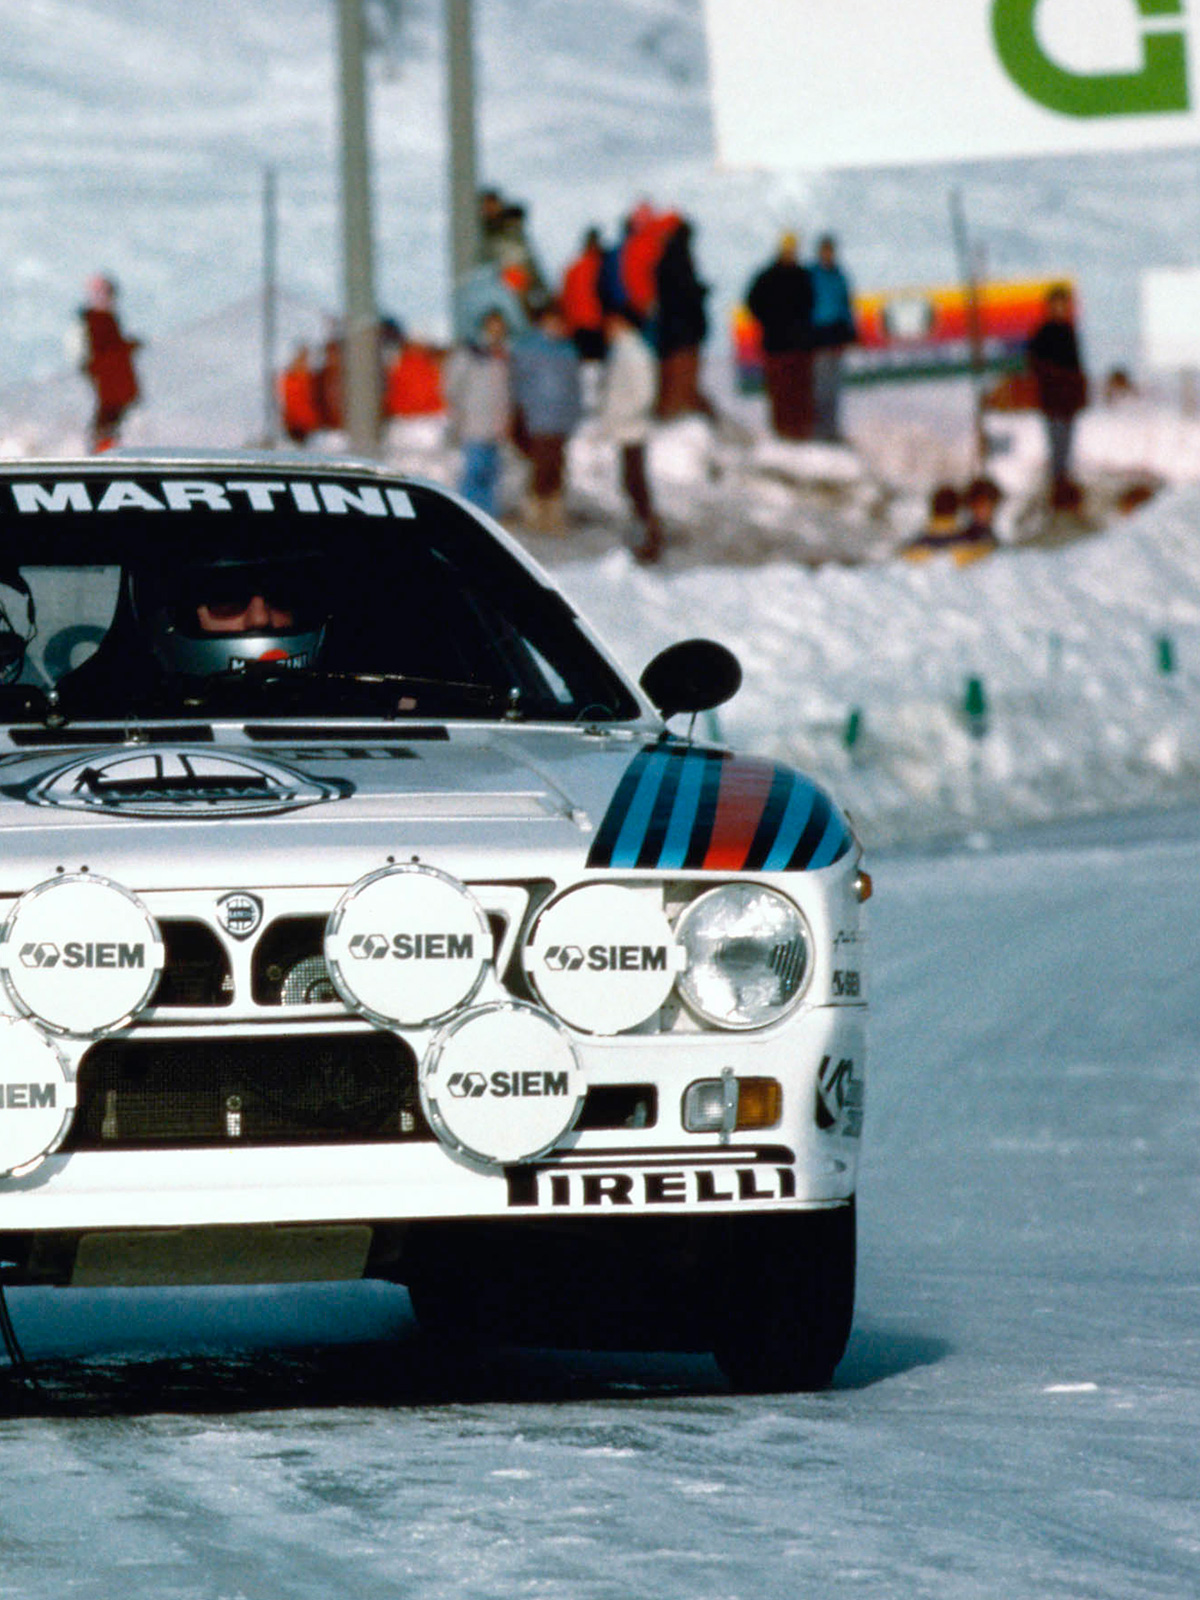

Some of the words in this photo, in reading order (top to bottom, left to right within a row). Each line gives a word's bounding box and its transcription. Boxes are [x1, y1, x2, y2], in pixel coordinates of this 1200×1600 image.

[11, 481, 417, 519] MARTINI
[62, 942, 145, 968] SIEM
[391, 934, 473, 959] SIEM
[586, 945, 667, 971] SIEM
[489, 1071, 569, 1097] SIEM
[503, 1144, 796, 1207] PIRELLI
